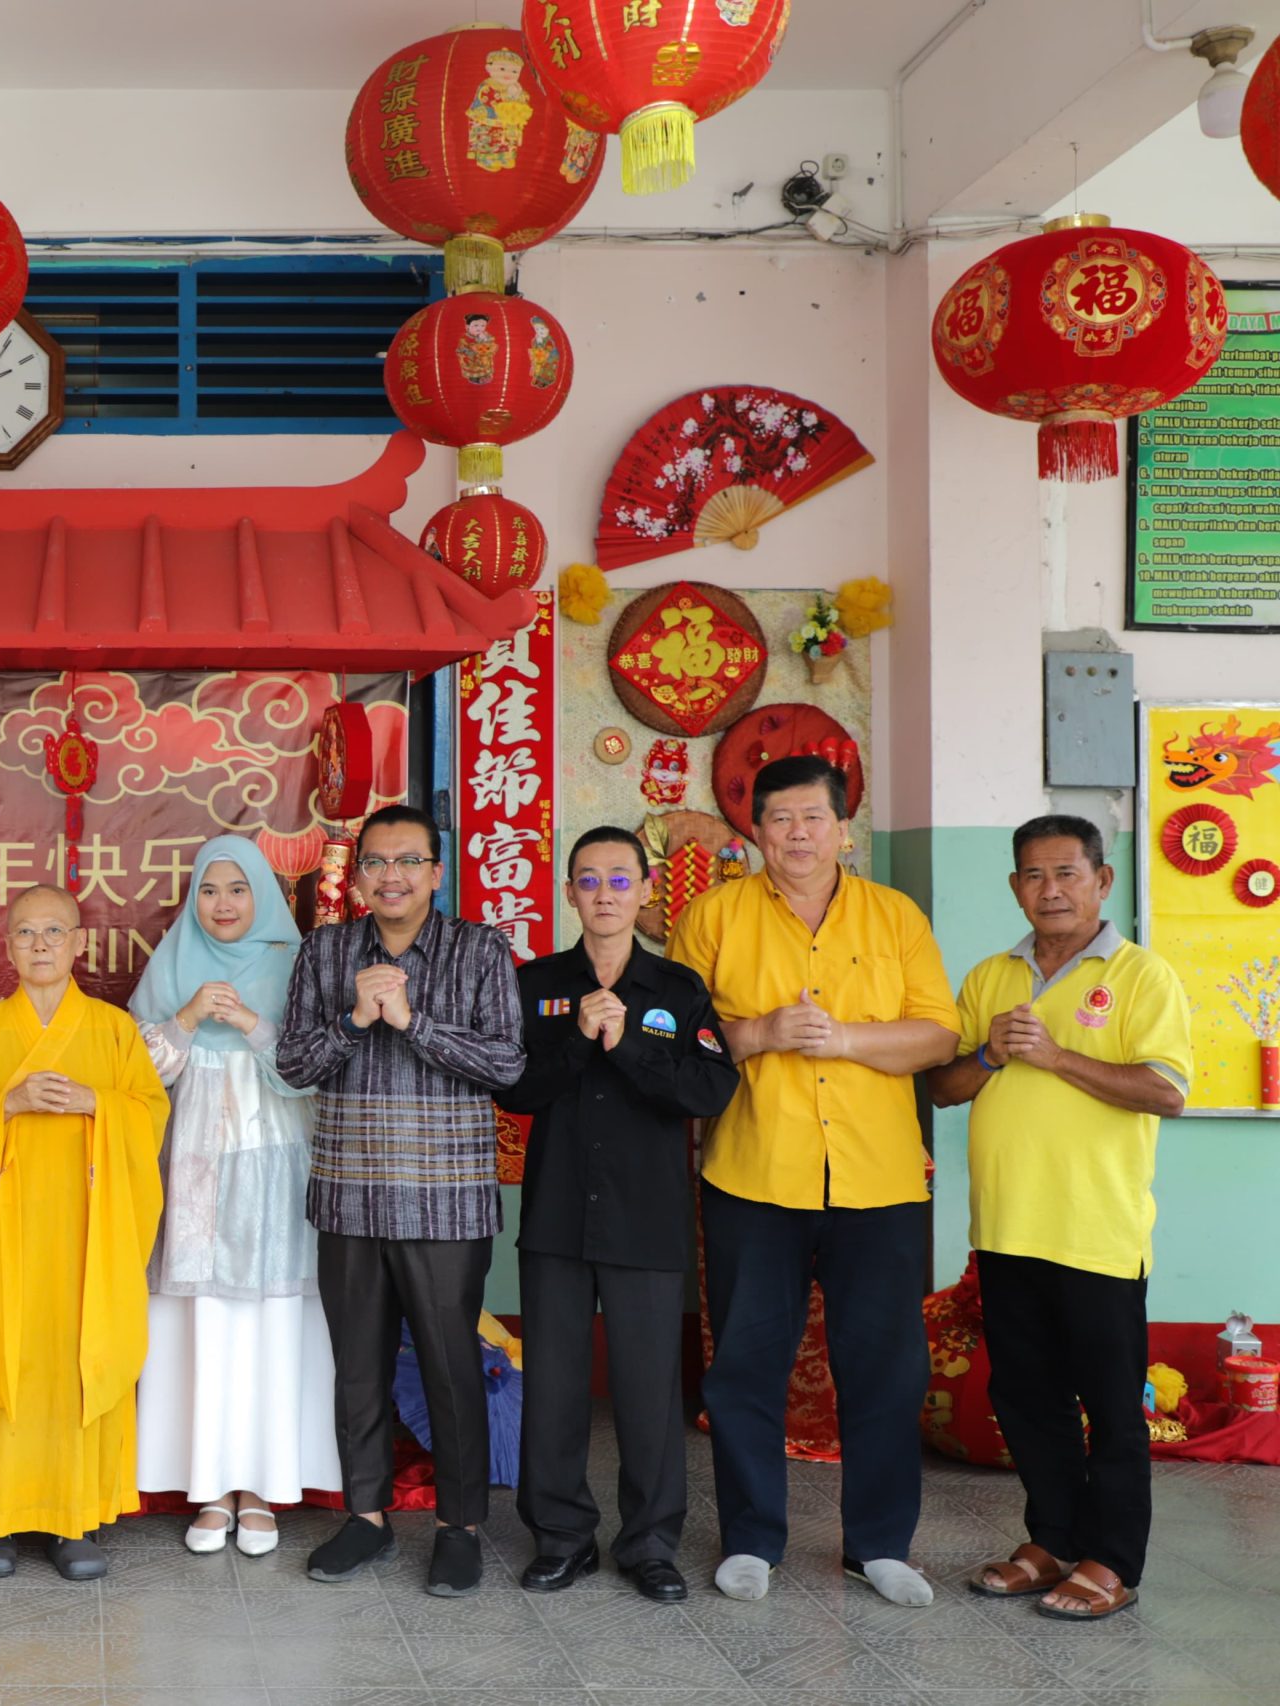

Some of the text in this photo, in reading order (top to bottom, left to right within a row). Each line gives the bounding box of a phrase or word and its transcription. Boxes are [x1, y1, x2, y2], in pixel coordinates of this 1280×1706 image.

[380, 54, 430, 181] 財源廣進
[1071, 264, 1137, 316] 福
[946, 284, 985, 341] 福
[1229, 315, 1267, 330] DAYA
[1221, 350, 1270, 361] terlambat
[1224, 367, 1256, 378] teman
[1140, 416, 1150, 428] 4.
[1154, 416, 1181, 429] MALU
[1182, 417, 1218, 429] karena
[1220, 417, 1259, 431] bekerja
[1140, 433, 1150, 445] 5.
[1154, 433, 1181, 445] MALU
[1182, 434, 1218, 446] karena
[1220, 434, 1259, 447] bekerja
[1153, 451, 1189, 463] aturan
[1139, 467, 1150, 479] 6.
[1154, 467, 1181, 479] MALU
[1182, 468, 1218, 480] karena
[1220, 468, 1259, 481] bekerja
[1139, 485, 1149, 497] 7.
[1151, 484, 1178, 497] MALU
[1179, 485, 1216, 497] karena
[1217, 486, 1246, 498] tugas
[1247, 486, 1275, 498] tidak
[1153, 502, 1225, 514] cepat/selesai
[1226, 503, 1253, 515] tepat
[1139, 519, 1149, 531] 8.
[1153, 519, 1180, 531] MALU
[1237, 520, 1257, 531] dan
[462, 518, 484, 580] 大吉大利
[1153, 537, 1185, 548] sopan
[1139, 553, 1150, 565] 9.
[1152, 553, 1180, 565] MALU
[1181, 554, 1209, 565] tidak
[1209, 554, 1255, 567] bertegur
[1153, 570, 1181, 582] MALU
[1181, 571, 1209, 582] tidak
[1209, 571, 1257, 583] berperan
[1152, 587, 1277, 600] mewujudkan kebersihan
[1152, 604, 1253, 616] lingkungan sekolah
[651, 606, 726, 680] 福
[618, 653, 652, 669] 恭喜
[726, 646, 759, 664] 發財
[1186, 825, 1219, 856] 福
[642, 1025, 676, 1040] WALUBI
